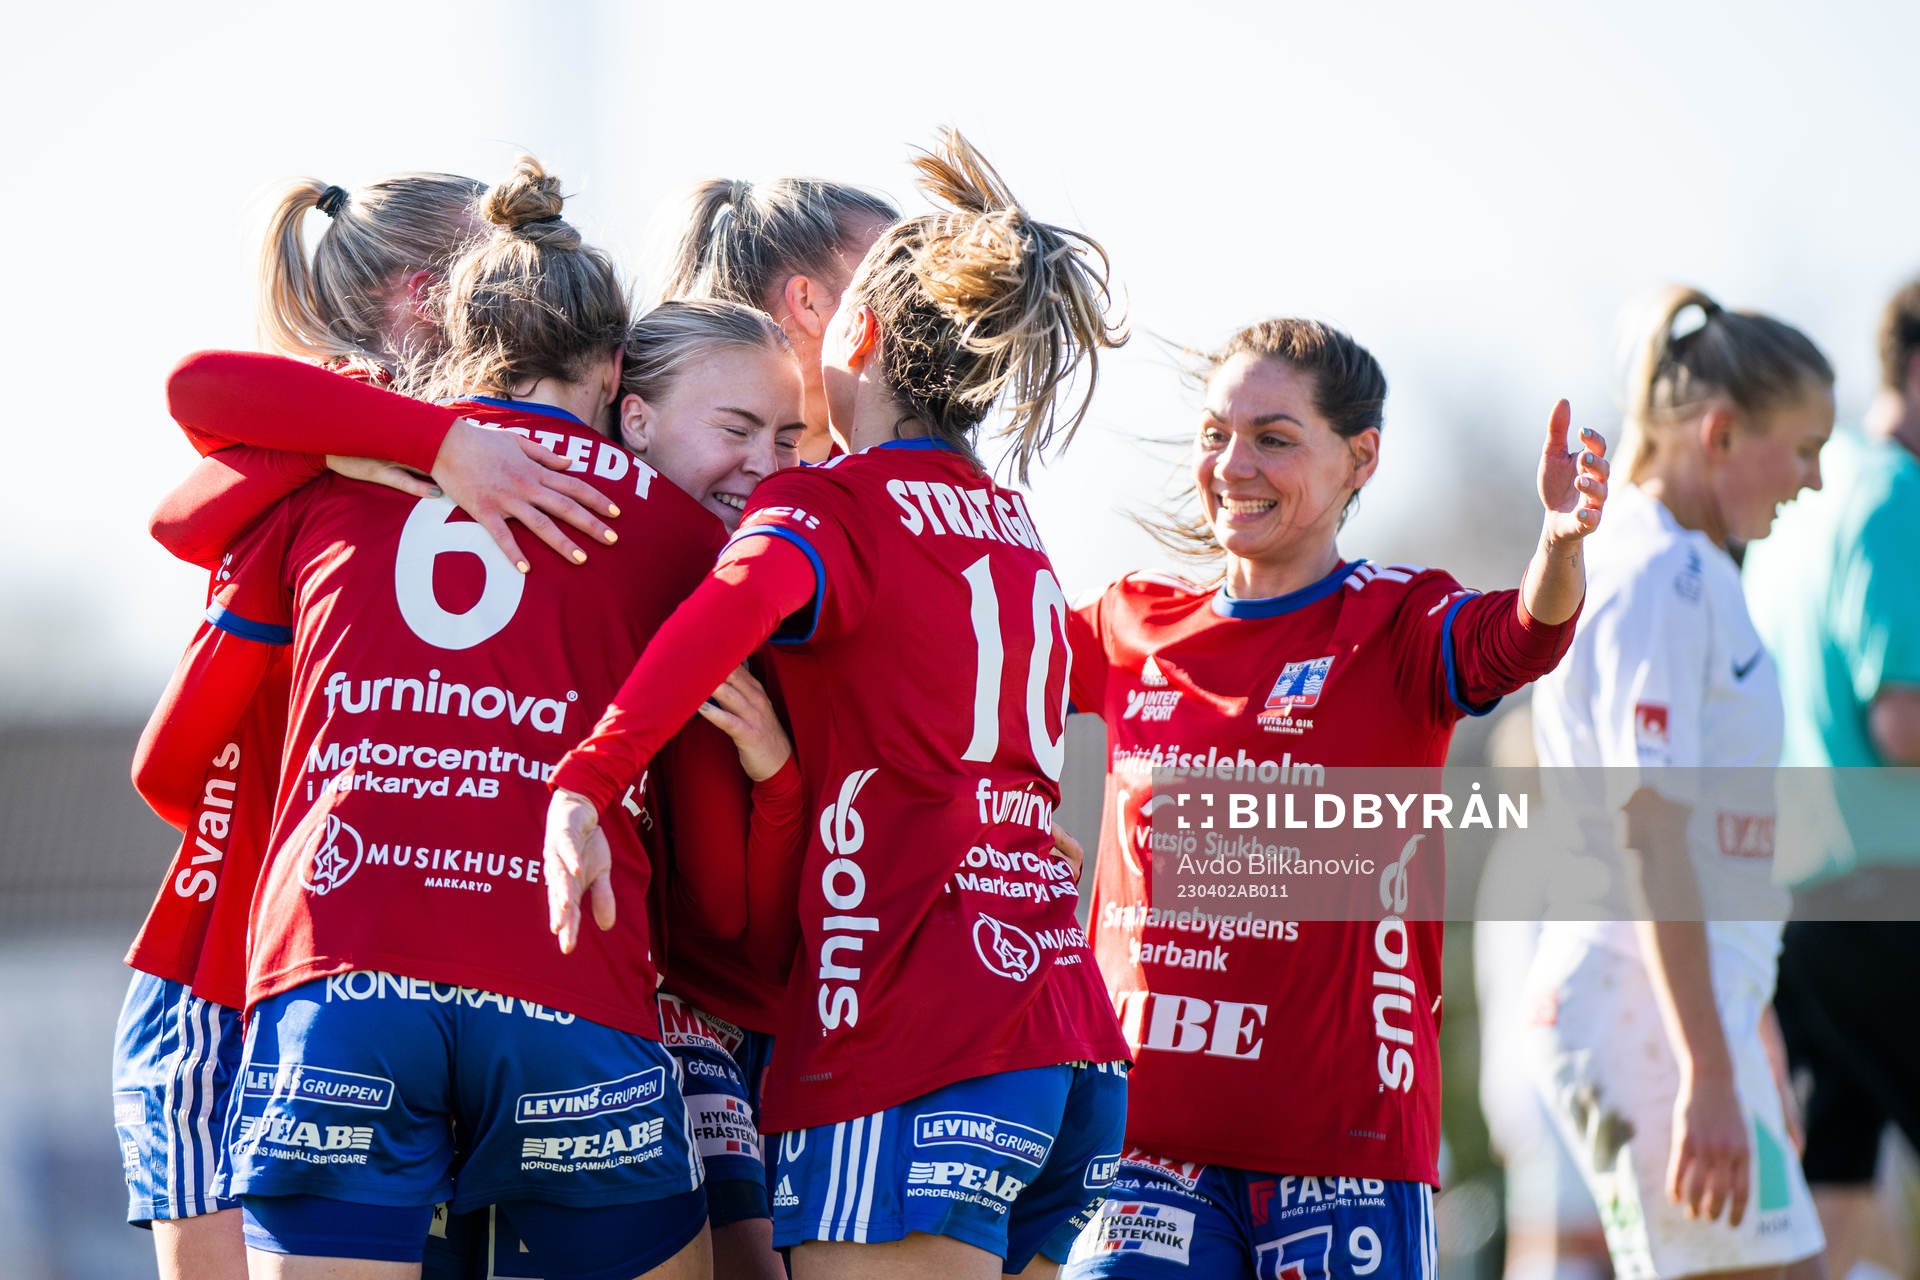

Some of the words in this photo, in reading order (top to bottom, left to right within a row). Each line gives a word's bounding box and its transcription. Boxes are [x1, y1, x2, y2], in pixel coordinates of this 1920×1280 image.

[465, 417, 658, 500] TEDT
[395, 497, 526, 650] 6
[962, 554, 1073, 783] 10
[455, 777, 500, 799] AB
[175, 742, 240, 902] Svans
[366, 843, 549, 886] MUSIKHUSE
[424, 876, 492, 893] MARKARYD
[688, 1059, 727, 1079] GÖSTA
[303, 1078, 384, 1102] GRUPPEN
[524, 1088, 600, 1116] LEVINS
[601, 1080, 658, 1107] GRUPPEN
[540, 1122, 654, 1161] PEAB
[922, 1119, 997, 1142] LEVINS
[995, 1133, 1047, 1159] GRUPPEN
[521, 1160, 574, 1174] NORDENS
[575, 1145, 664, 1172] SAMHÄLLSBYGGARE
[928, 1161, 1024, 1202] PEAB
[1280, 1175, 1386, 1208] FASAB
[1281, 1206, 1304, 1220] BYGG
[1359, 1197, 1386, 1208] MARK
[1349, 1225, 1383, 1275] 9
